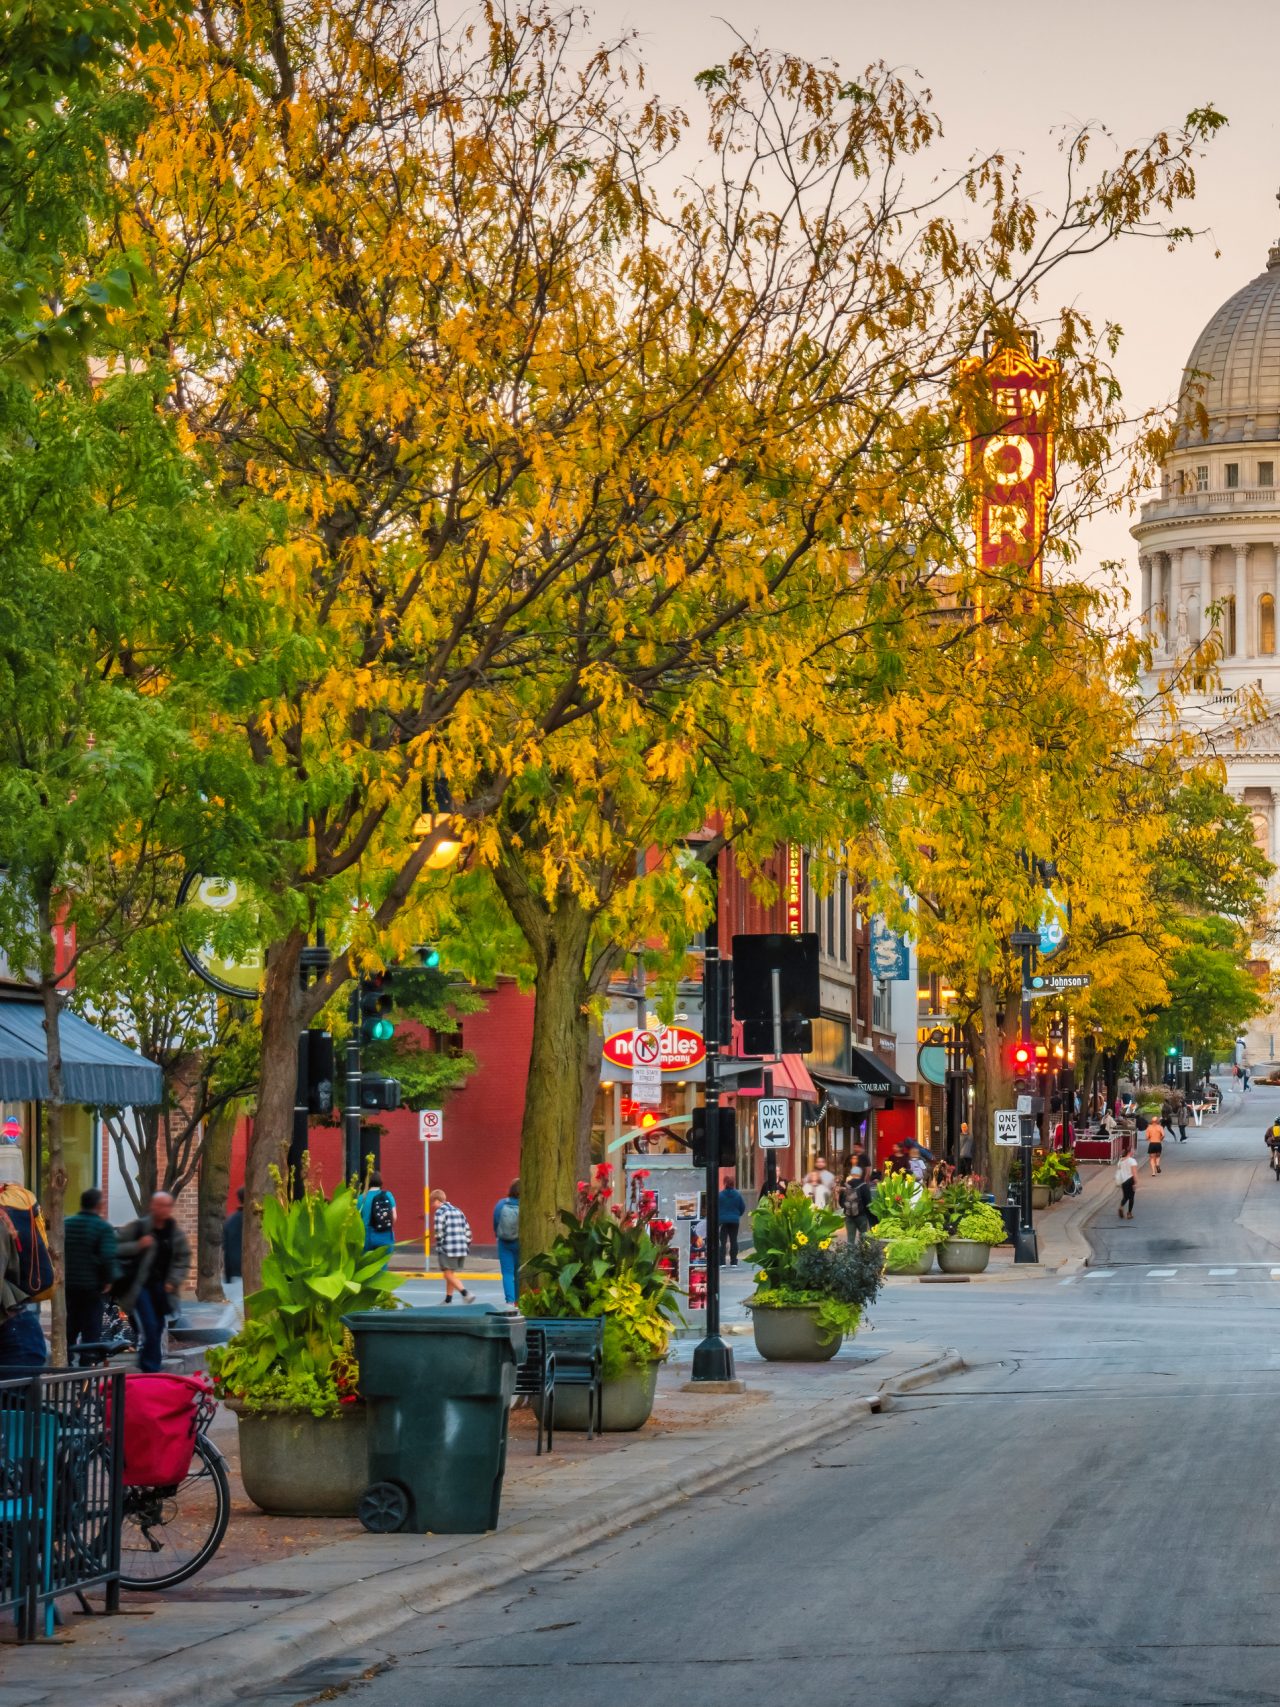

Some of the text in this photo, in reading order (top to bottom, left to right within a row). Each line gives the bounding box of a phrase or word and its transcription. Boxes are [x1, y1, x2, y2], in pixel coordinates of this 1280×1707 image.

[1050, 976, 1082, 987] Johnson
[615, 1030, 698, 1055] ndles
[763, 1104, 784, 1116] ONE
[763, 1118, 784, 1129] WAY
[998, 1114, 1017, 1123] ONE
[998, 1124, 1017, 1132] WAY
